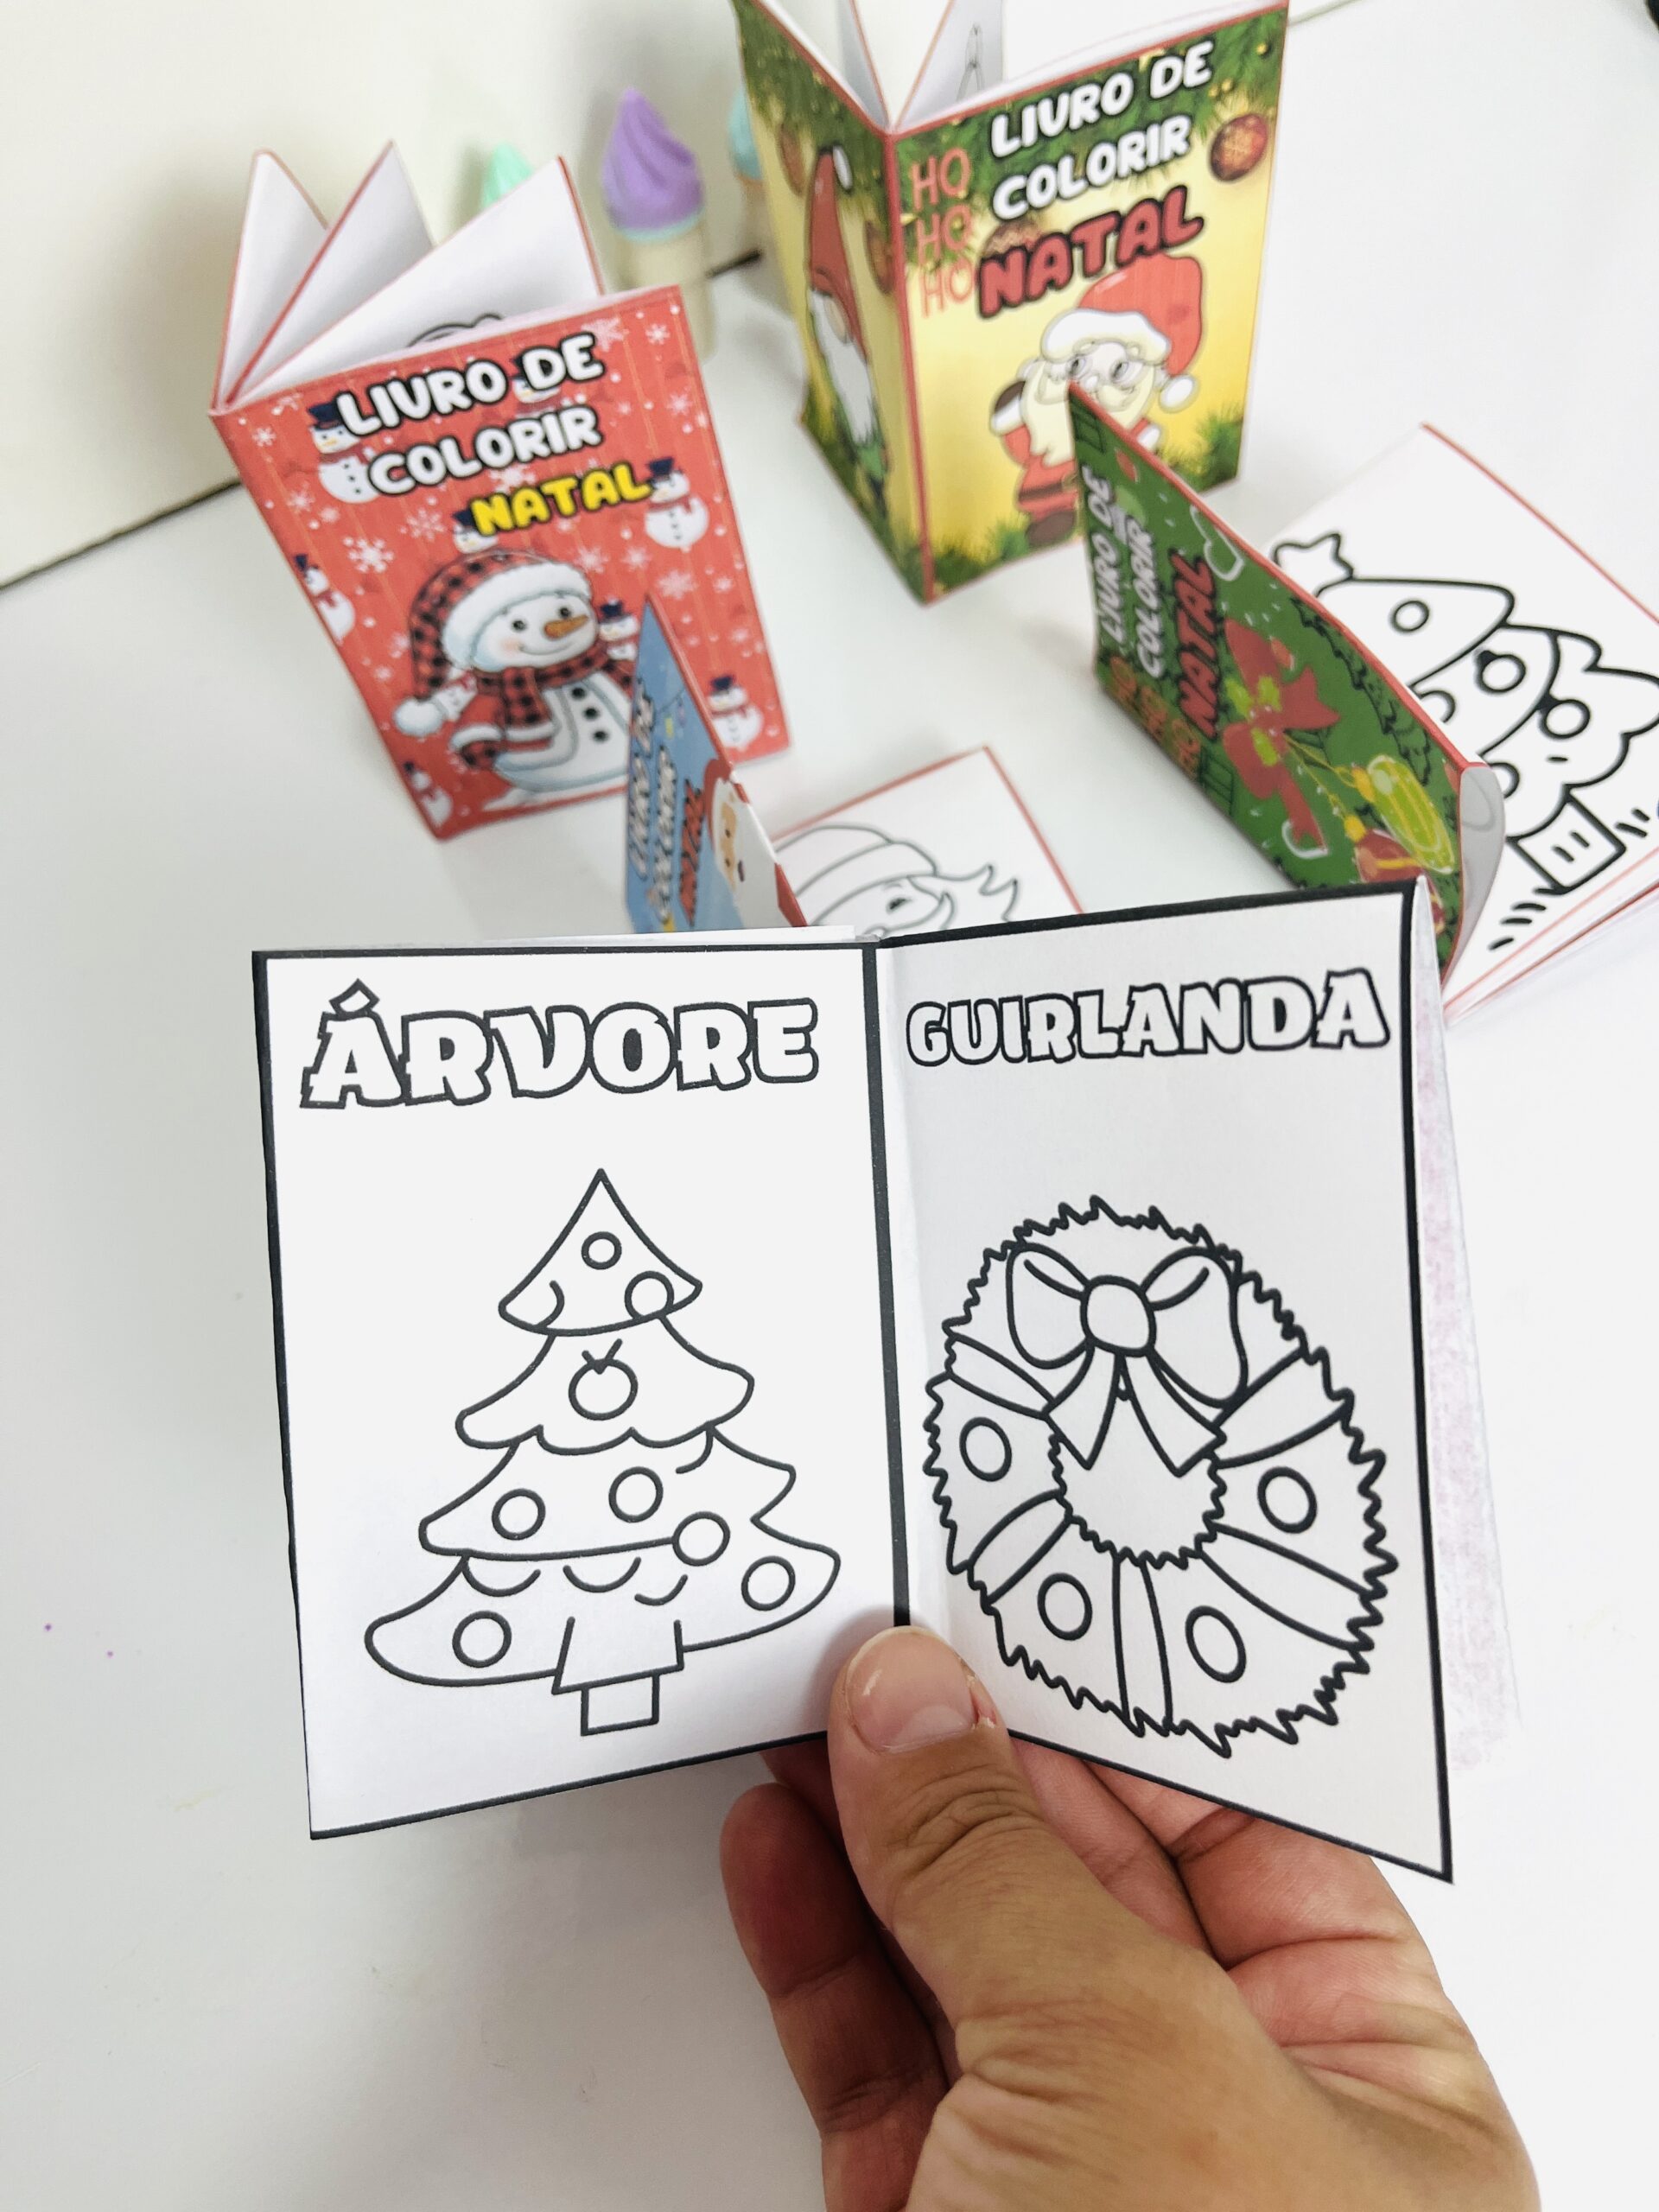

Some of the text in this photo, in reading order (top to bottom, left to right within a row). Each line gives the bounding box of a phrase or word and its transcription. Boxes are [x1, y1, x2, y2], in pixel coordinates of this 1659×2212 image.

[990, 40, 1214, 158] LIVRO DE
[912, 147, 970, 206] HO
[992, 115, 1194, 221] COLORIR
[916, 204, 972, 261] HO
[978, 185, 1205, 320] NATAL
[923, 261, 975, 317] HO
[337, 332, 605, 436] LIVRO DE
[365, 405, 603, 495] COLORIR
[470, 461, 652, 537] NATAL
[1169, 548, 1219, 740] NATAL
[299, 977, 819, 1109] ÁRVORE
[906, 967, 1392, 1066] GUIRLANDA
